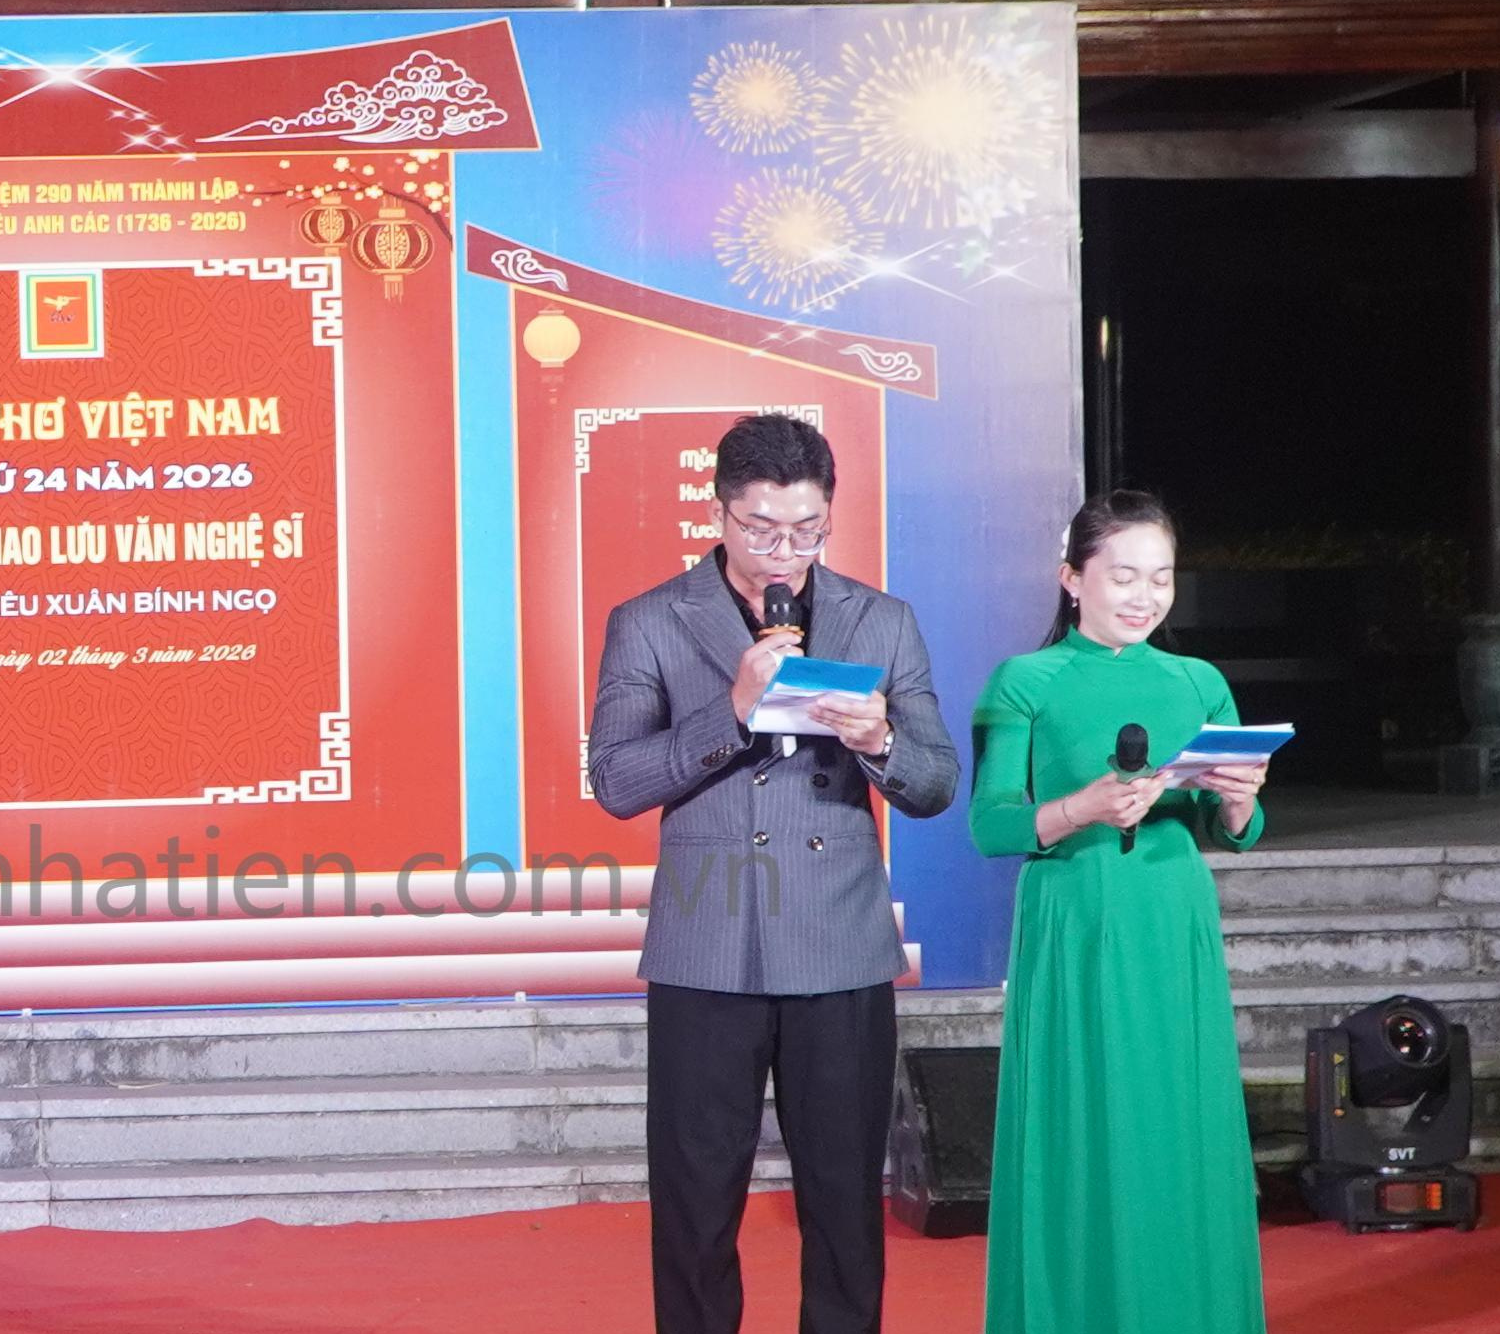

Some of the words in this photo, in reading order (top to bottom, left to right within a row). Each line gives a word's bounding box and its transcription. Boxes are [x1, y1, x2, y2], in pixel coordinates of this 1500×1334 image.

[36, 184, 72, 203] 290
[77, 179, 124, 203] NĂM
[129, 178, 194, 202] THÀNH
[201, 177, 239, 204] LẬP
[23, 215, 64, 235] ANH
[70, 210, 110, 234] CÁC
[117, 213, 171, 234] (1736
[191, 211, 246, 232] 2026)
[77, 391, 174, 447] VIỆT
[187, 396, 281, 436] NAM
[23, 467, 67, 493] 24
[75, 460, 155, 491] NĂM
[162, 463, 254, 489] 2026
[50, 520, 108, 564] LƯU
[114, 515, 175, 563] VĂN
[184, 513, 265, 568] NGHỆ
[272, 511, 305, 558] SĨ
[45, 587, 128, 615] XUÂN
[133, 587, 205, 613] BÍNH
[212, 588, 278, 615] NGỌ
[37, 648, 65, 667] 02
[68, 646, 128, 671] tháng
[131, 646, 149, 664] 3
[148, 647, 195, 664] năm
[198, 643, 257, 662] 2026
